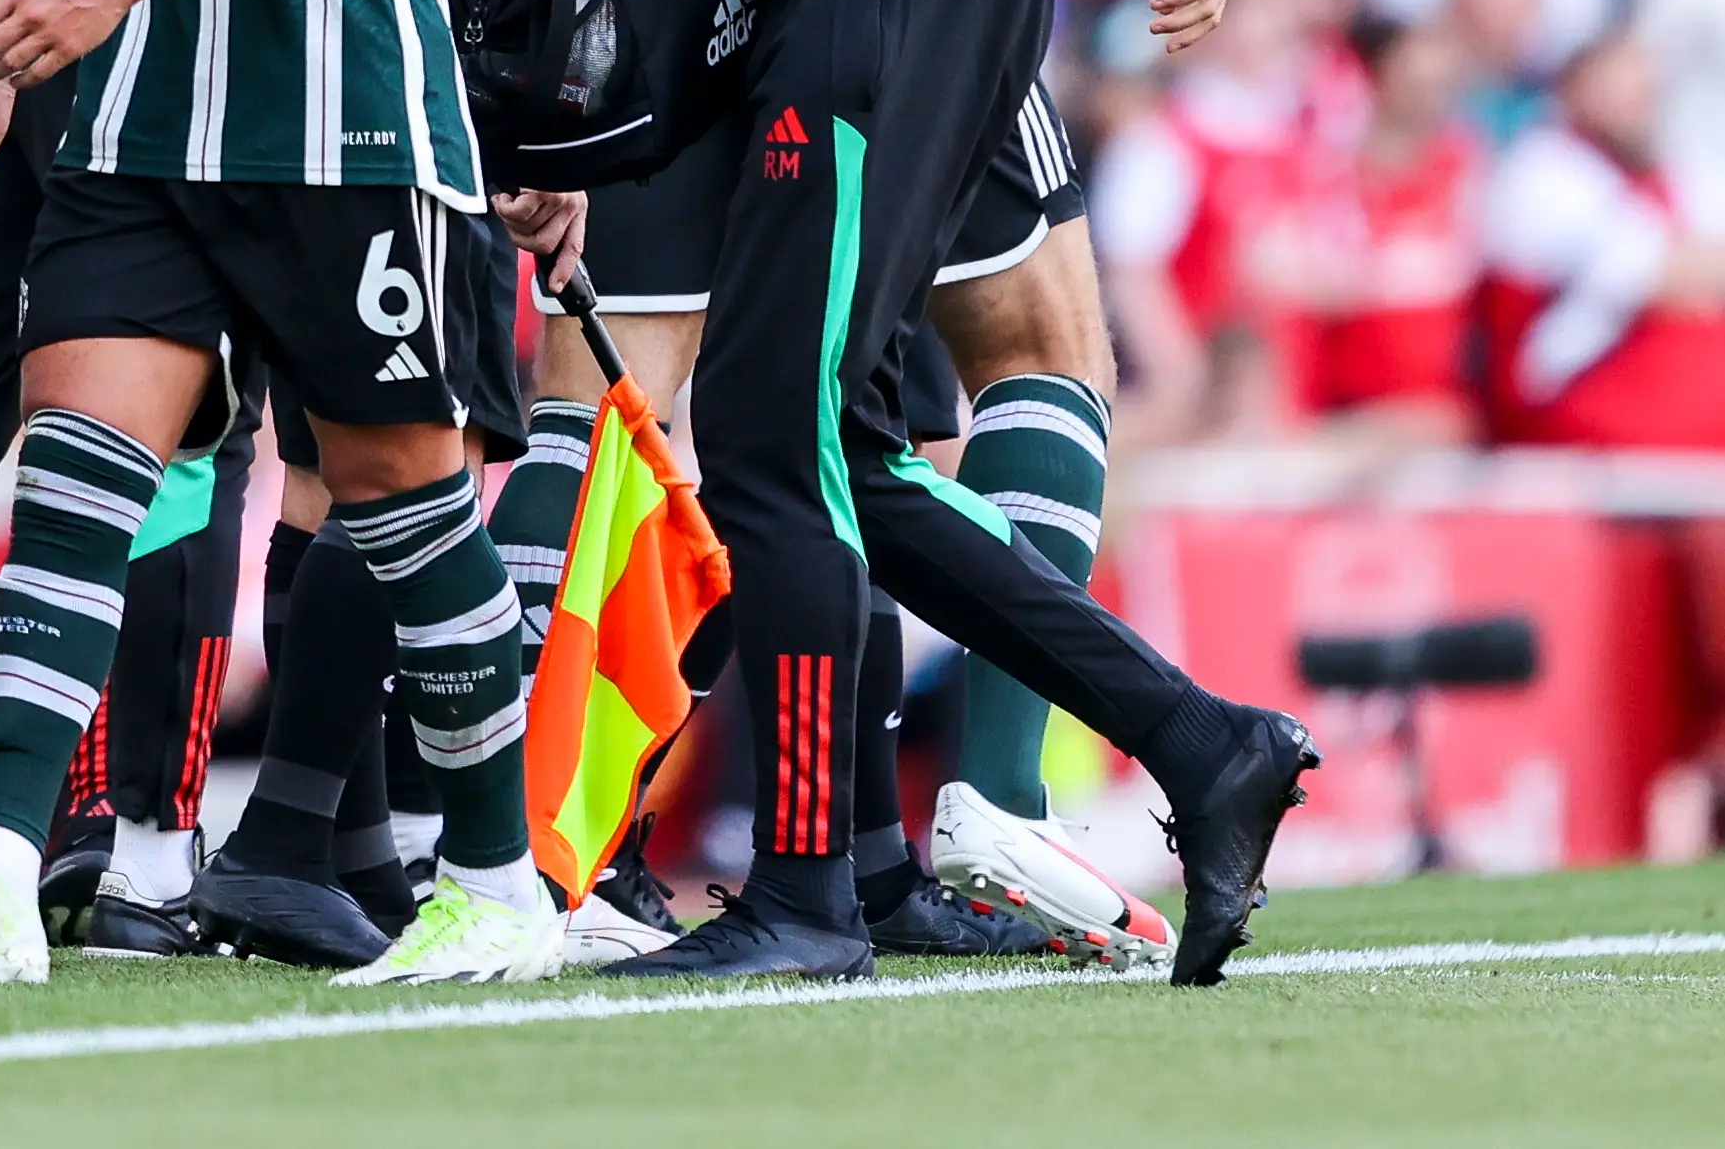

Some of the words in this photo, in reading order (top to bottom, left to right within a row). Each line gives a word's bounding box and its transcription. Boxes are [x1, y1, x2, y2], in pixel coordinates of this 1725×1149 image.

[340, 130, 397, 146] HEAT.RDY
[764, 150, 800, 182] RM
[357, 230, 424, 337] 6
[420, 681, 474, 695] UNITED
